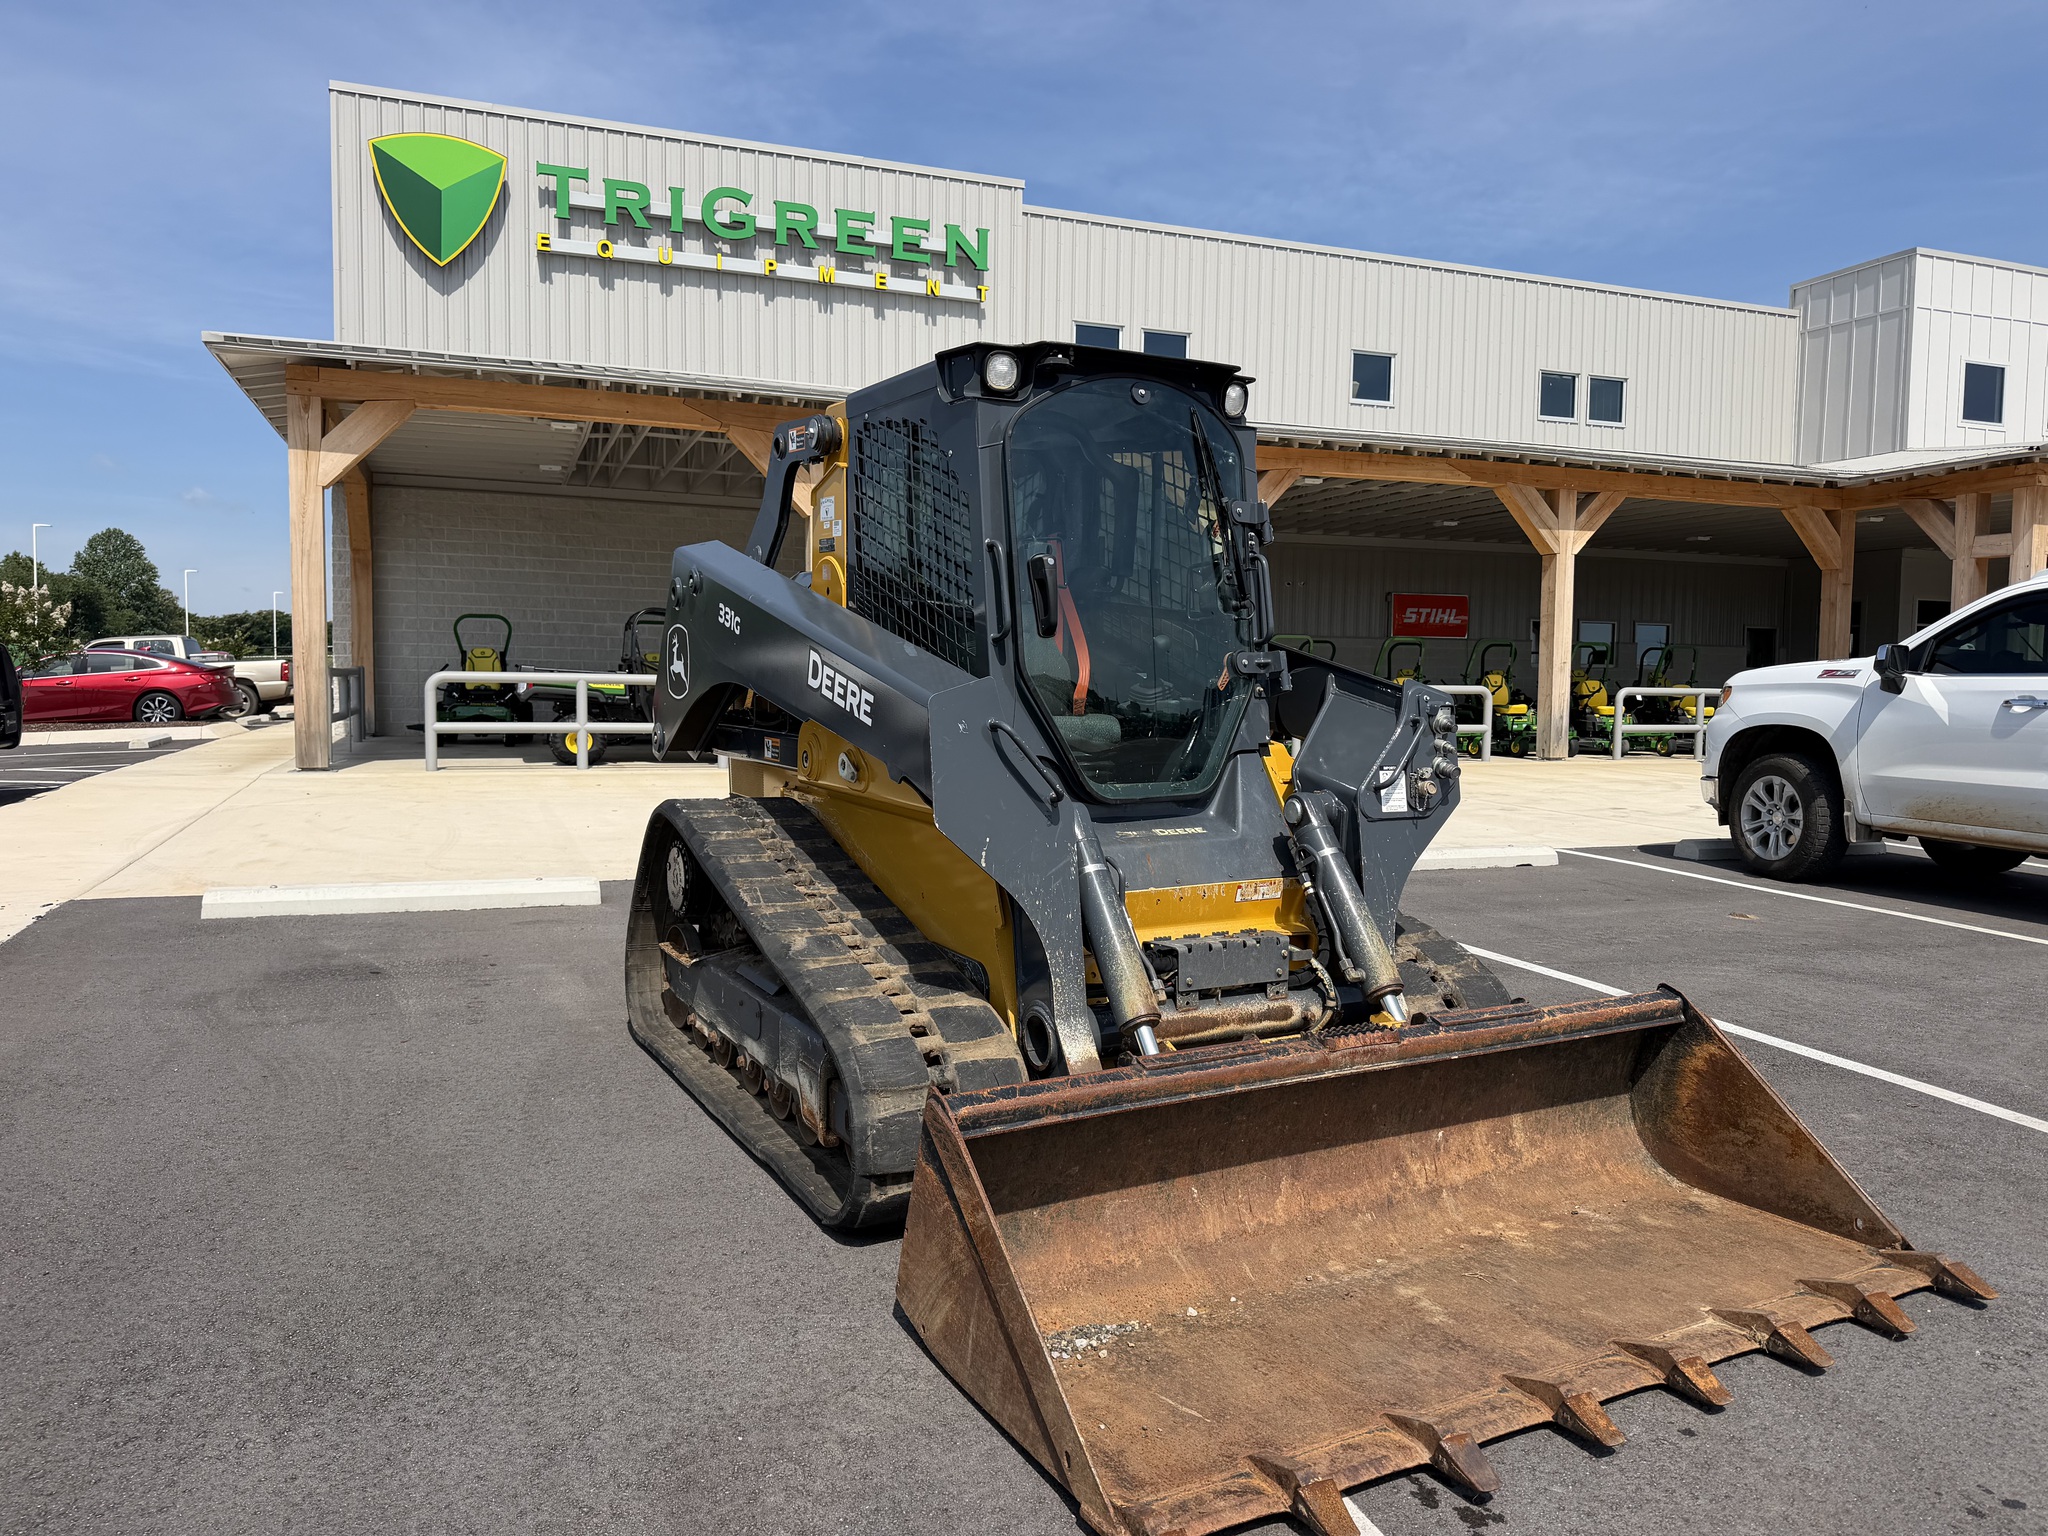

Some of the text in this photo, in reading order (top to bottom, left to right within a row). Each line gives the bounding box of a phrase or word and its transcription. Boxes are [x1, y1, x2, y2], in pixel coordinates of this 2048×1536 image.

[536, 162, 989, 271] TRIGREEN
[536, 233, 989, 303] EQUIPMENT
[718, 602, 741, 635] 331G
[1403, 607, 1461, 624] STIHL
[807, 649, 874, 727] DEERE
[1152, 827, 1208, 836] DEERE
